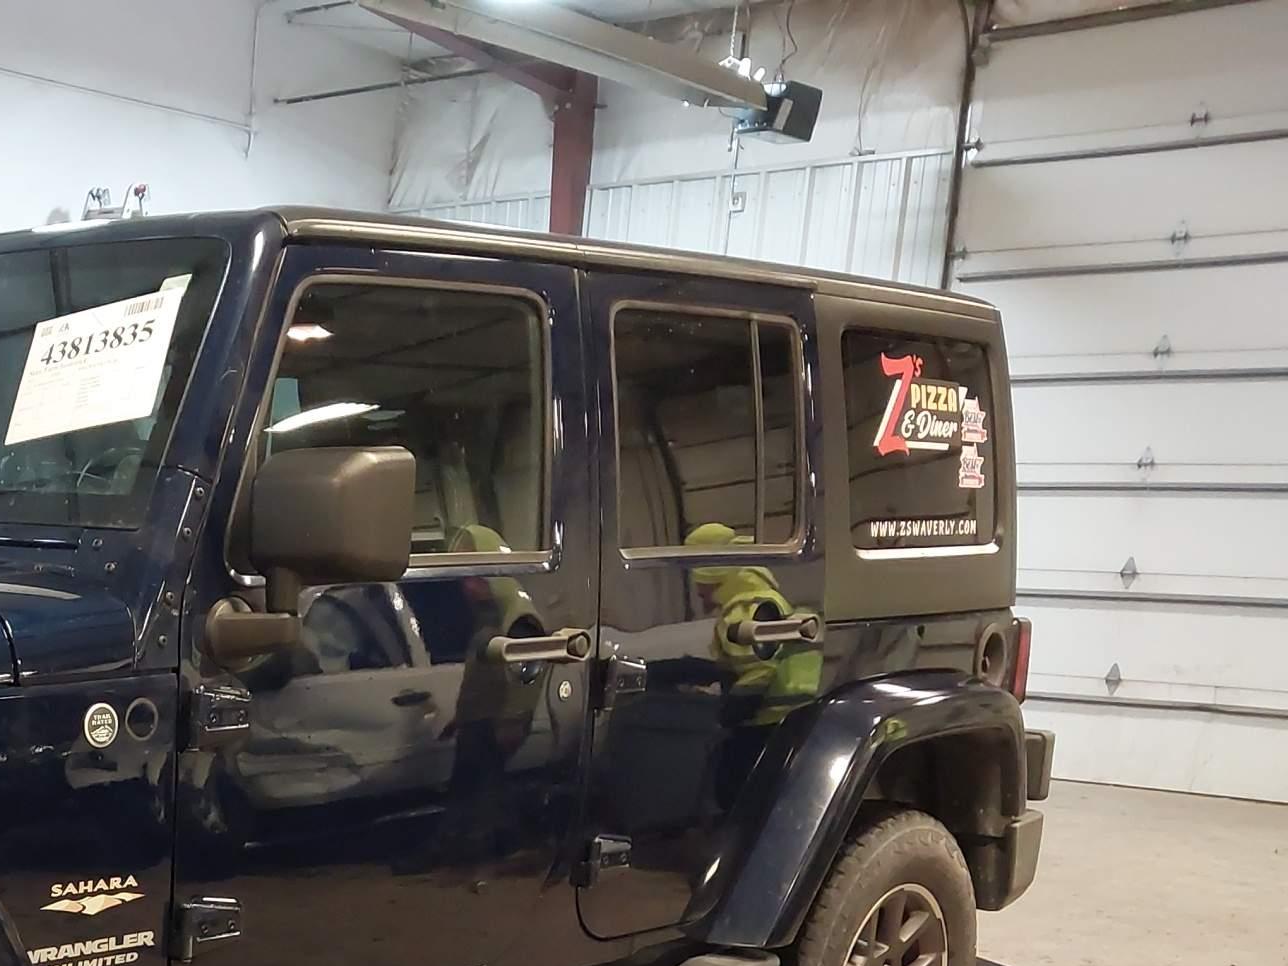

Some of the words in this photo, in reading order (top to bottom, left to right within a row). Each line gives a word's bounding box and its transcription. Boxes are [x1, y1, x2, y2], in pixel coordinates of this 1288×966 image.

[40, 319, 155, 366] 43813835
[910, 383, 957, 412] PIZZA
[901, 409, 916, 438] &
[916, 410, 958, 439] Diner
[870, 519, 977, 538] WWW.ZSWAVERLY.COM
[50, 875, 139, 897] SAHARA
